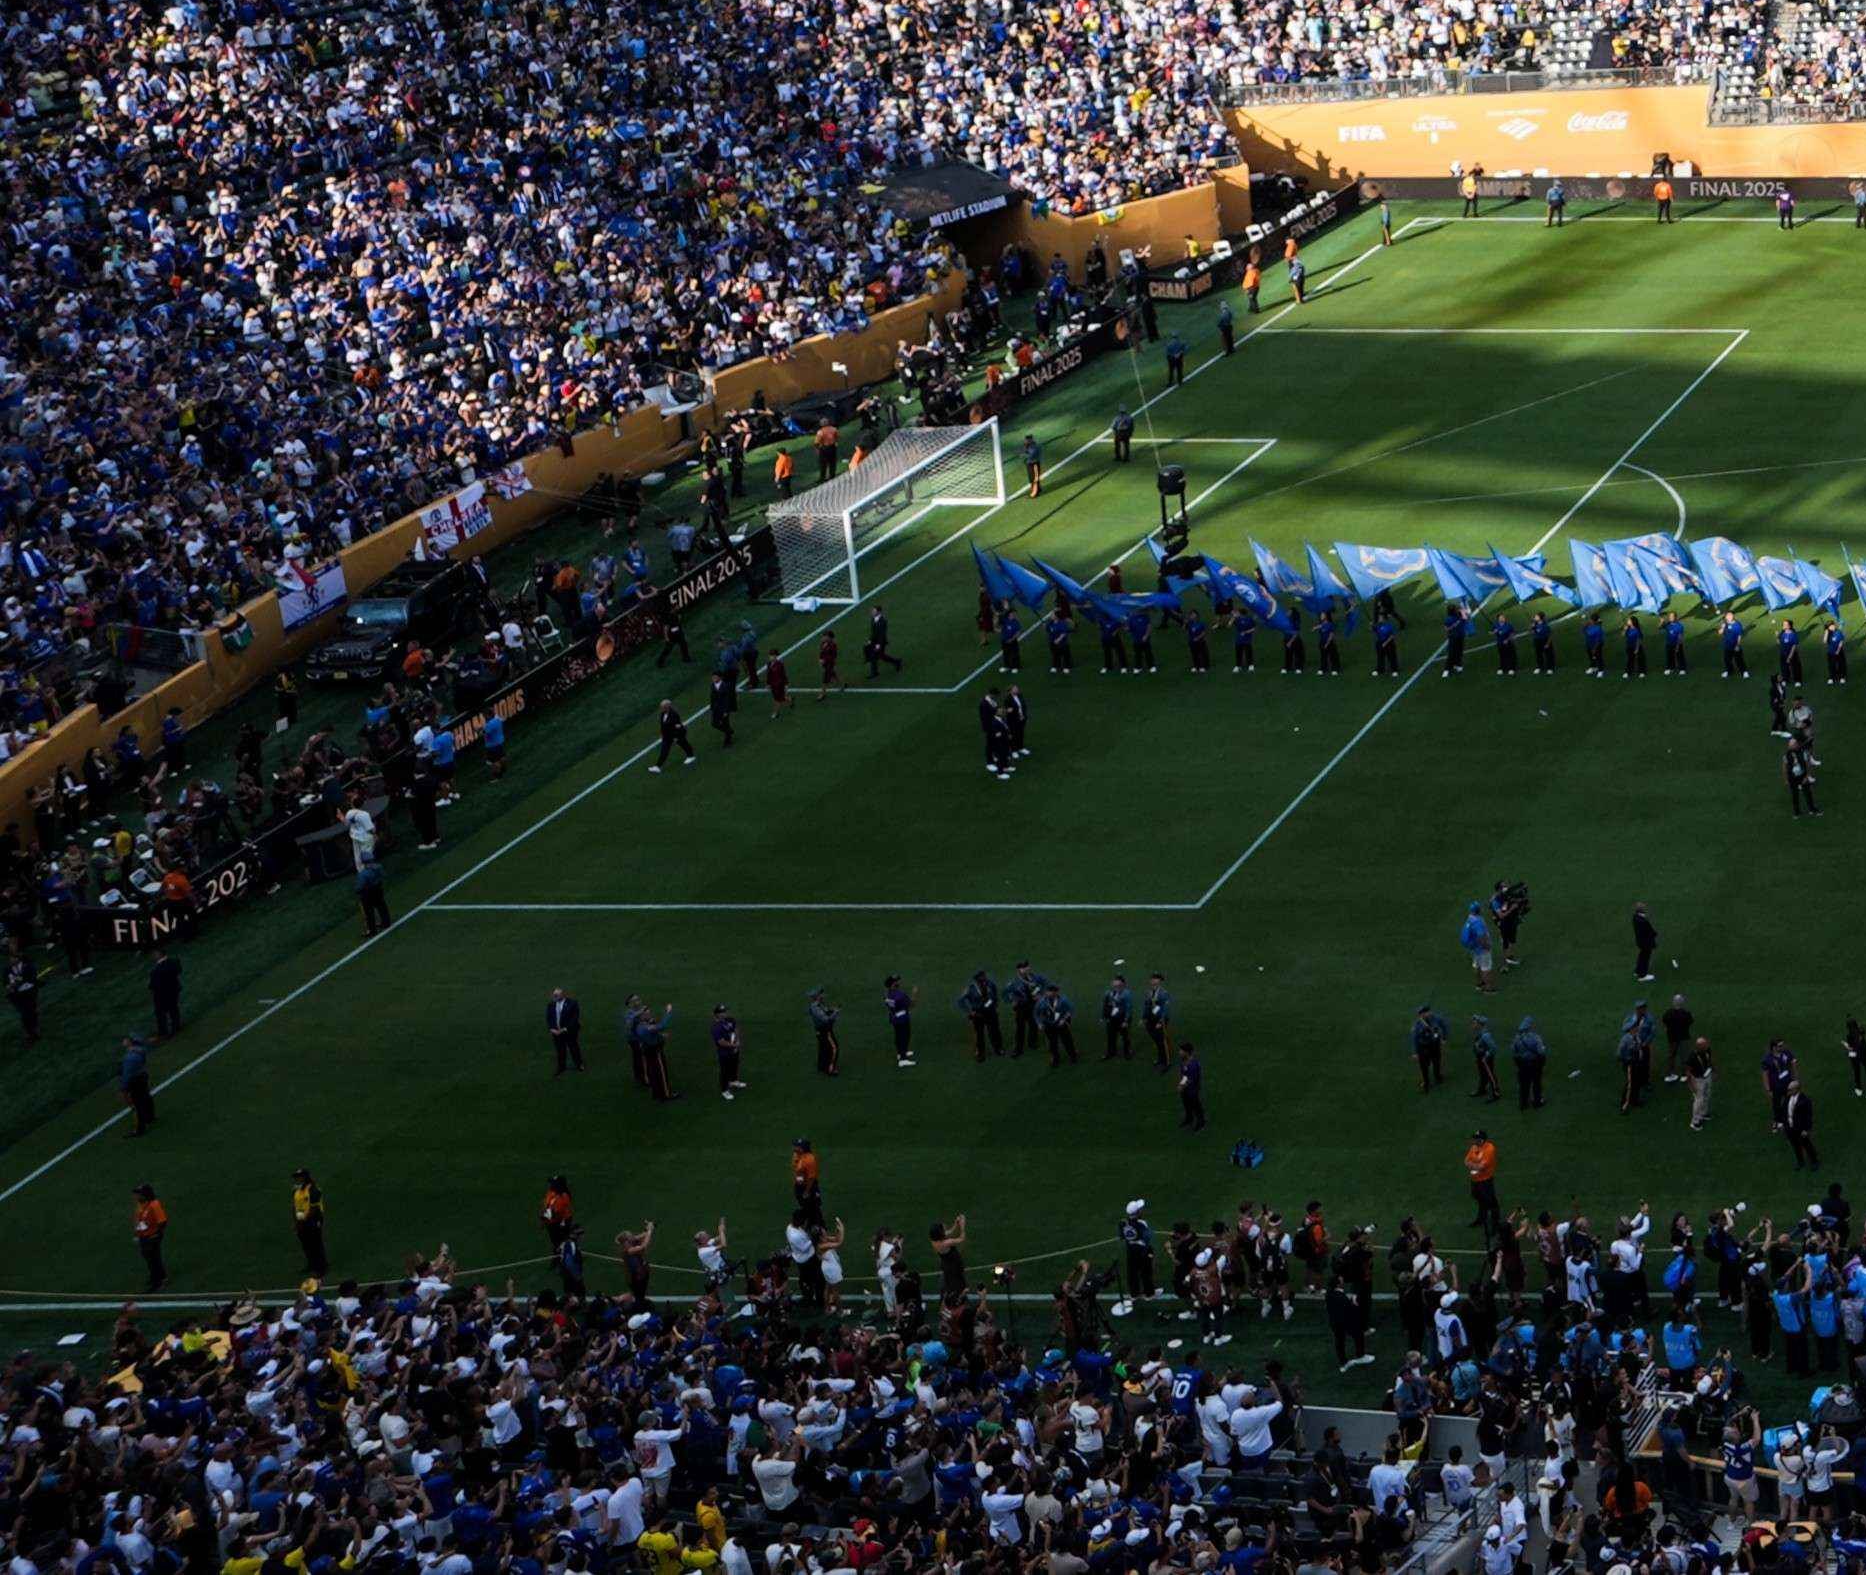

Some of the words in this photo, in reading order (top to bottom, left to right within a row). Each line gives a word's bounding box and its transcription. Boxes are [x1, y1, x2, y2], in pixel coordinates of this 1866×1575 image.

[1338, 125, 1387, 143] FIFA
[1566, 110, 1629, 134] Coca-Cola
[1690, 181, 1737, 197] FINAL
[669, 569, 717, 608] FINAL
[716, 544, 753, 584] 205
[206, 860, 249, 907] 202
